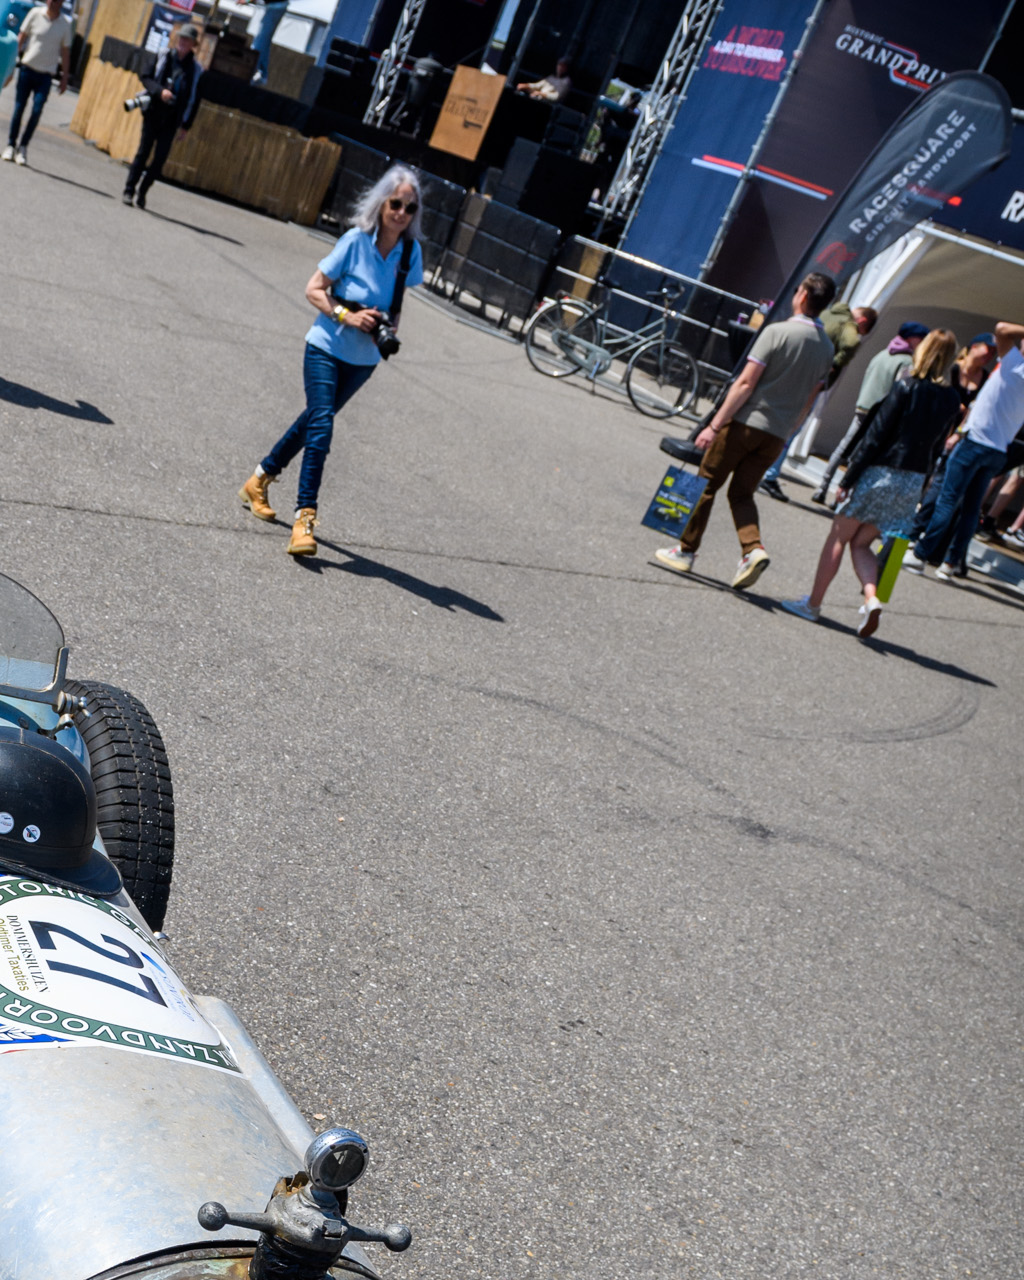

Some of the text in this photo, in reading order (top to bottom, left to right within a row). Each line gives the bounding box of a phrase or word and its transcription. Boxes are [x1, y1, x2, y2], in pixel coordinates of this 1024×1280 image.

[835, 33, 904, 70] GRAND
[849, 109, 965, 234] RACESQUARE
[865, 122, 977, 242] CIRCUIT ZANDVOORT
[6, 915, 51, 993] DOMMERSHUIZEN
[7, 955, 30, 992] Taxaties
[28, 920, 168, 1008] 27
